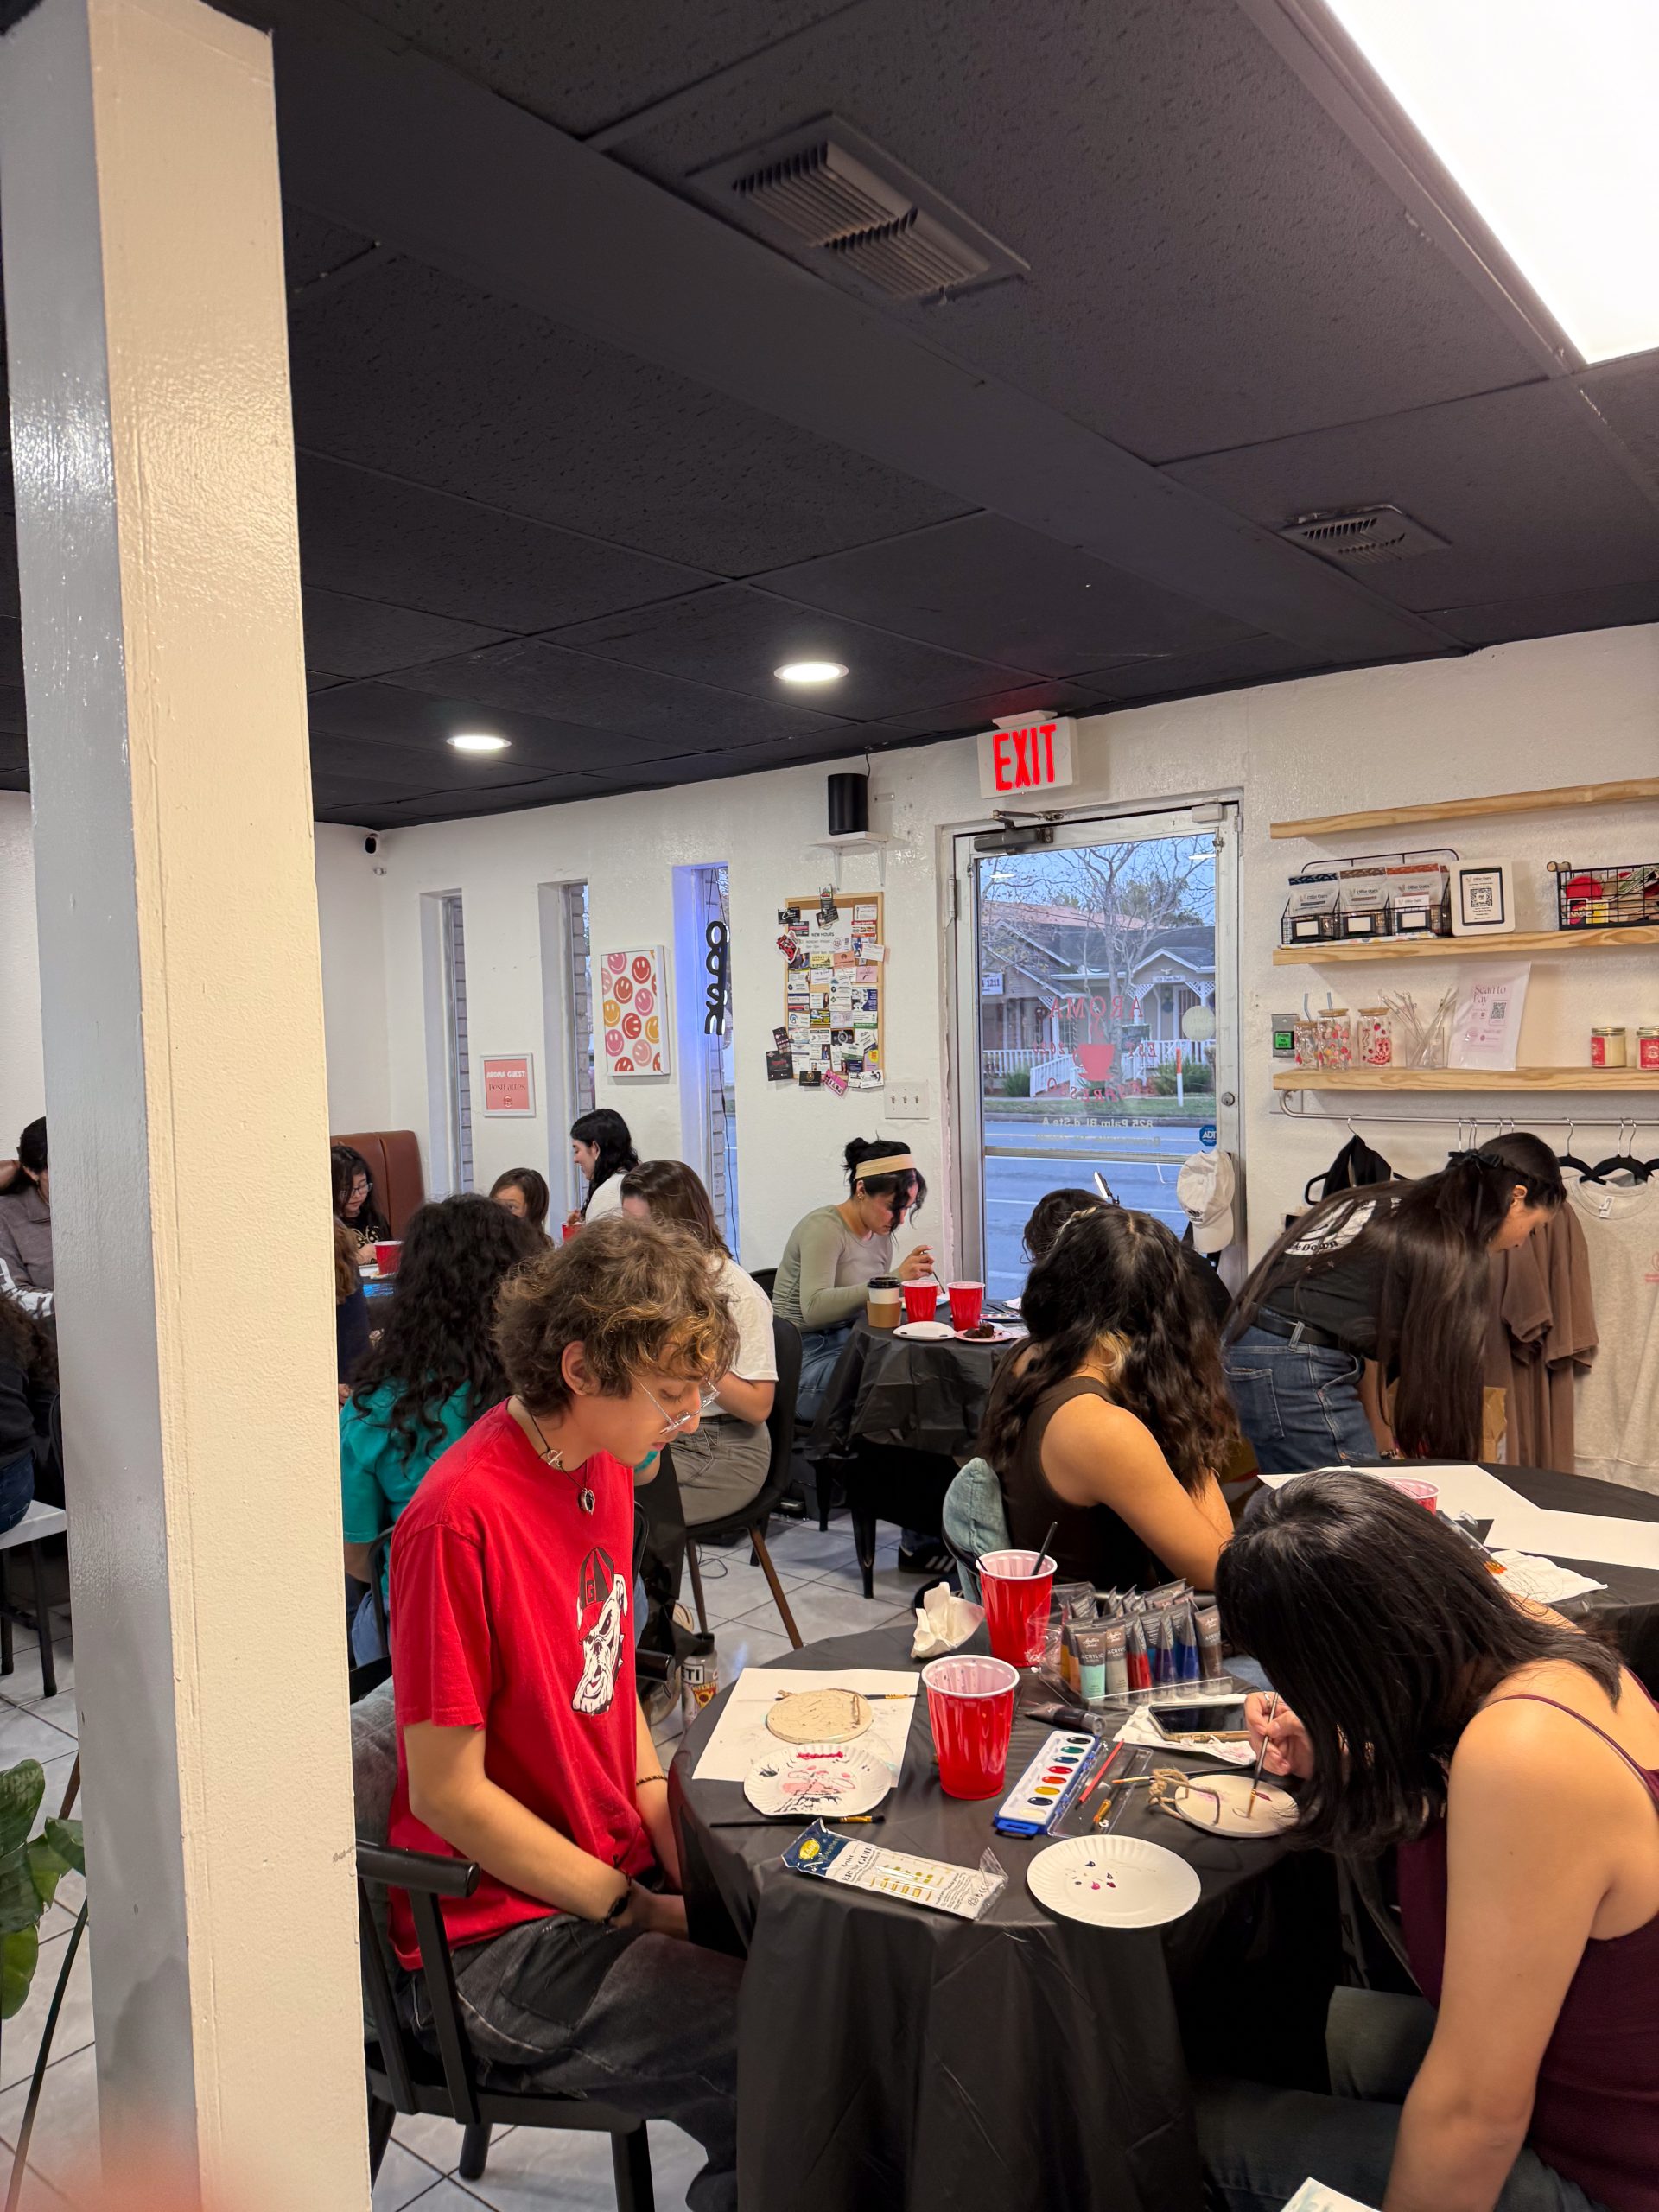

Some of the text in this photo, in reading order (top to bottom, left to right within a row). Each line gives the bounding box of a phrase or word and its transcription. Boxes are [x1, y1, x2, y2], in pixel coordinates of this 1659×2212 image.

[992, 722, 1057, 792] EXIT
[1497, 985, 1506, 995] to
[1472, 994, 1487, 1006] Pay
[1202, 1130, 1217, 1139] ADT
